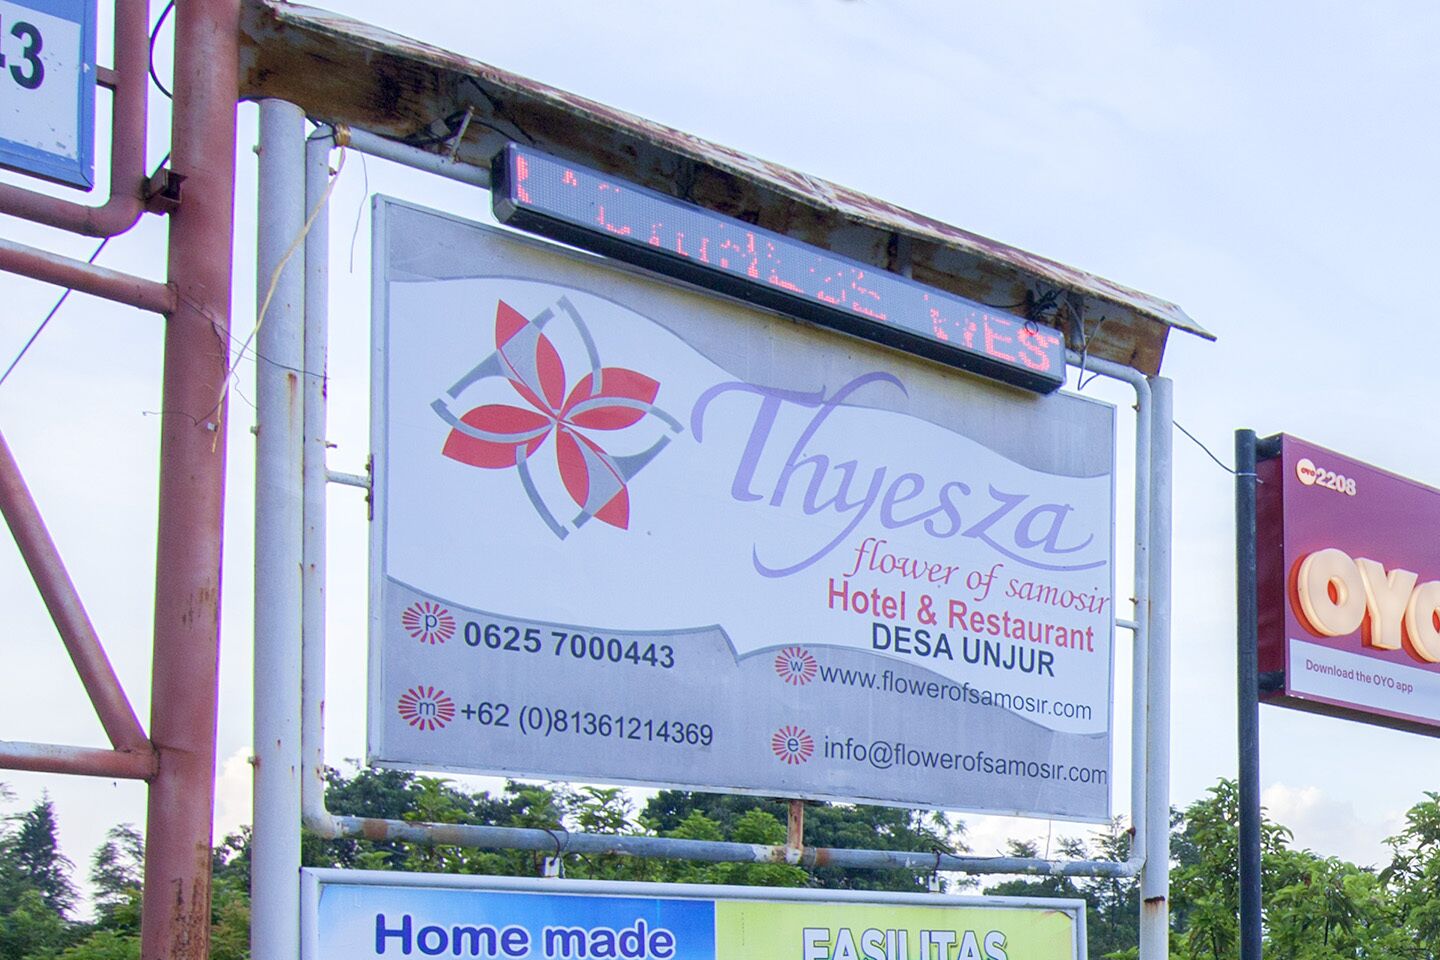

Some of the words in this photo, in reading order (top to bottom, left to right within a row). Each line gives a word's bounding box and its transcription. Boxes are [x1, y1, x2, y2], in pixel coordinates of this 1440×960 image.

[690, 371, 1108, 579] Thyesza
[1316, 468, 1356, 496] 2208
[843, 537, 959, 586] flower
[966, 563, 1004, 602] of
[1005, 578, 1110, 615] samosir
[828, 578, 906, 621] Hotel
[917, 594, 938, 626] &
[949, 599, 1095, 652] Restaurant
[464, 621, 542, 653] 0625
[551, 631, 675, 669] 7000443
[872, 622, 954, 661] DESA
[963, 636, 1055, 678] UNJUR
[819, 665, 1092, 721] www.flowerofsamosir.com
[1305, 659, 1354, 680] Download
[1356, 671, 1372, 684] the
[1373, 674, 1394, 689] OYO
[1396, 681, 1414, 694] app
[461, 702, 510, 728] +62
[519, 704, 713, 747] (0)81361214369
[824, 735, 1108, 785] info@flowerofsamosir.com
[375, 913, 529, 957] Home
[545, 920, 675, 959] made
